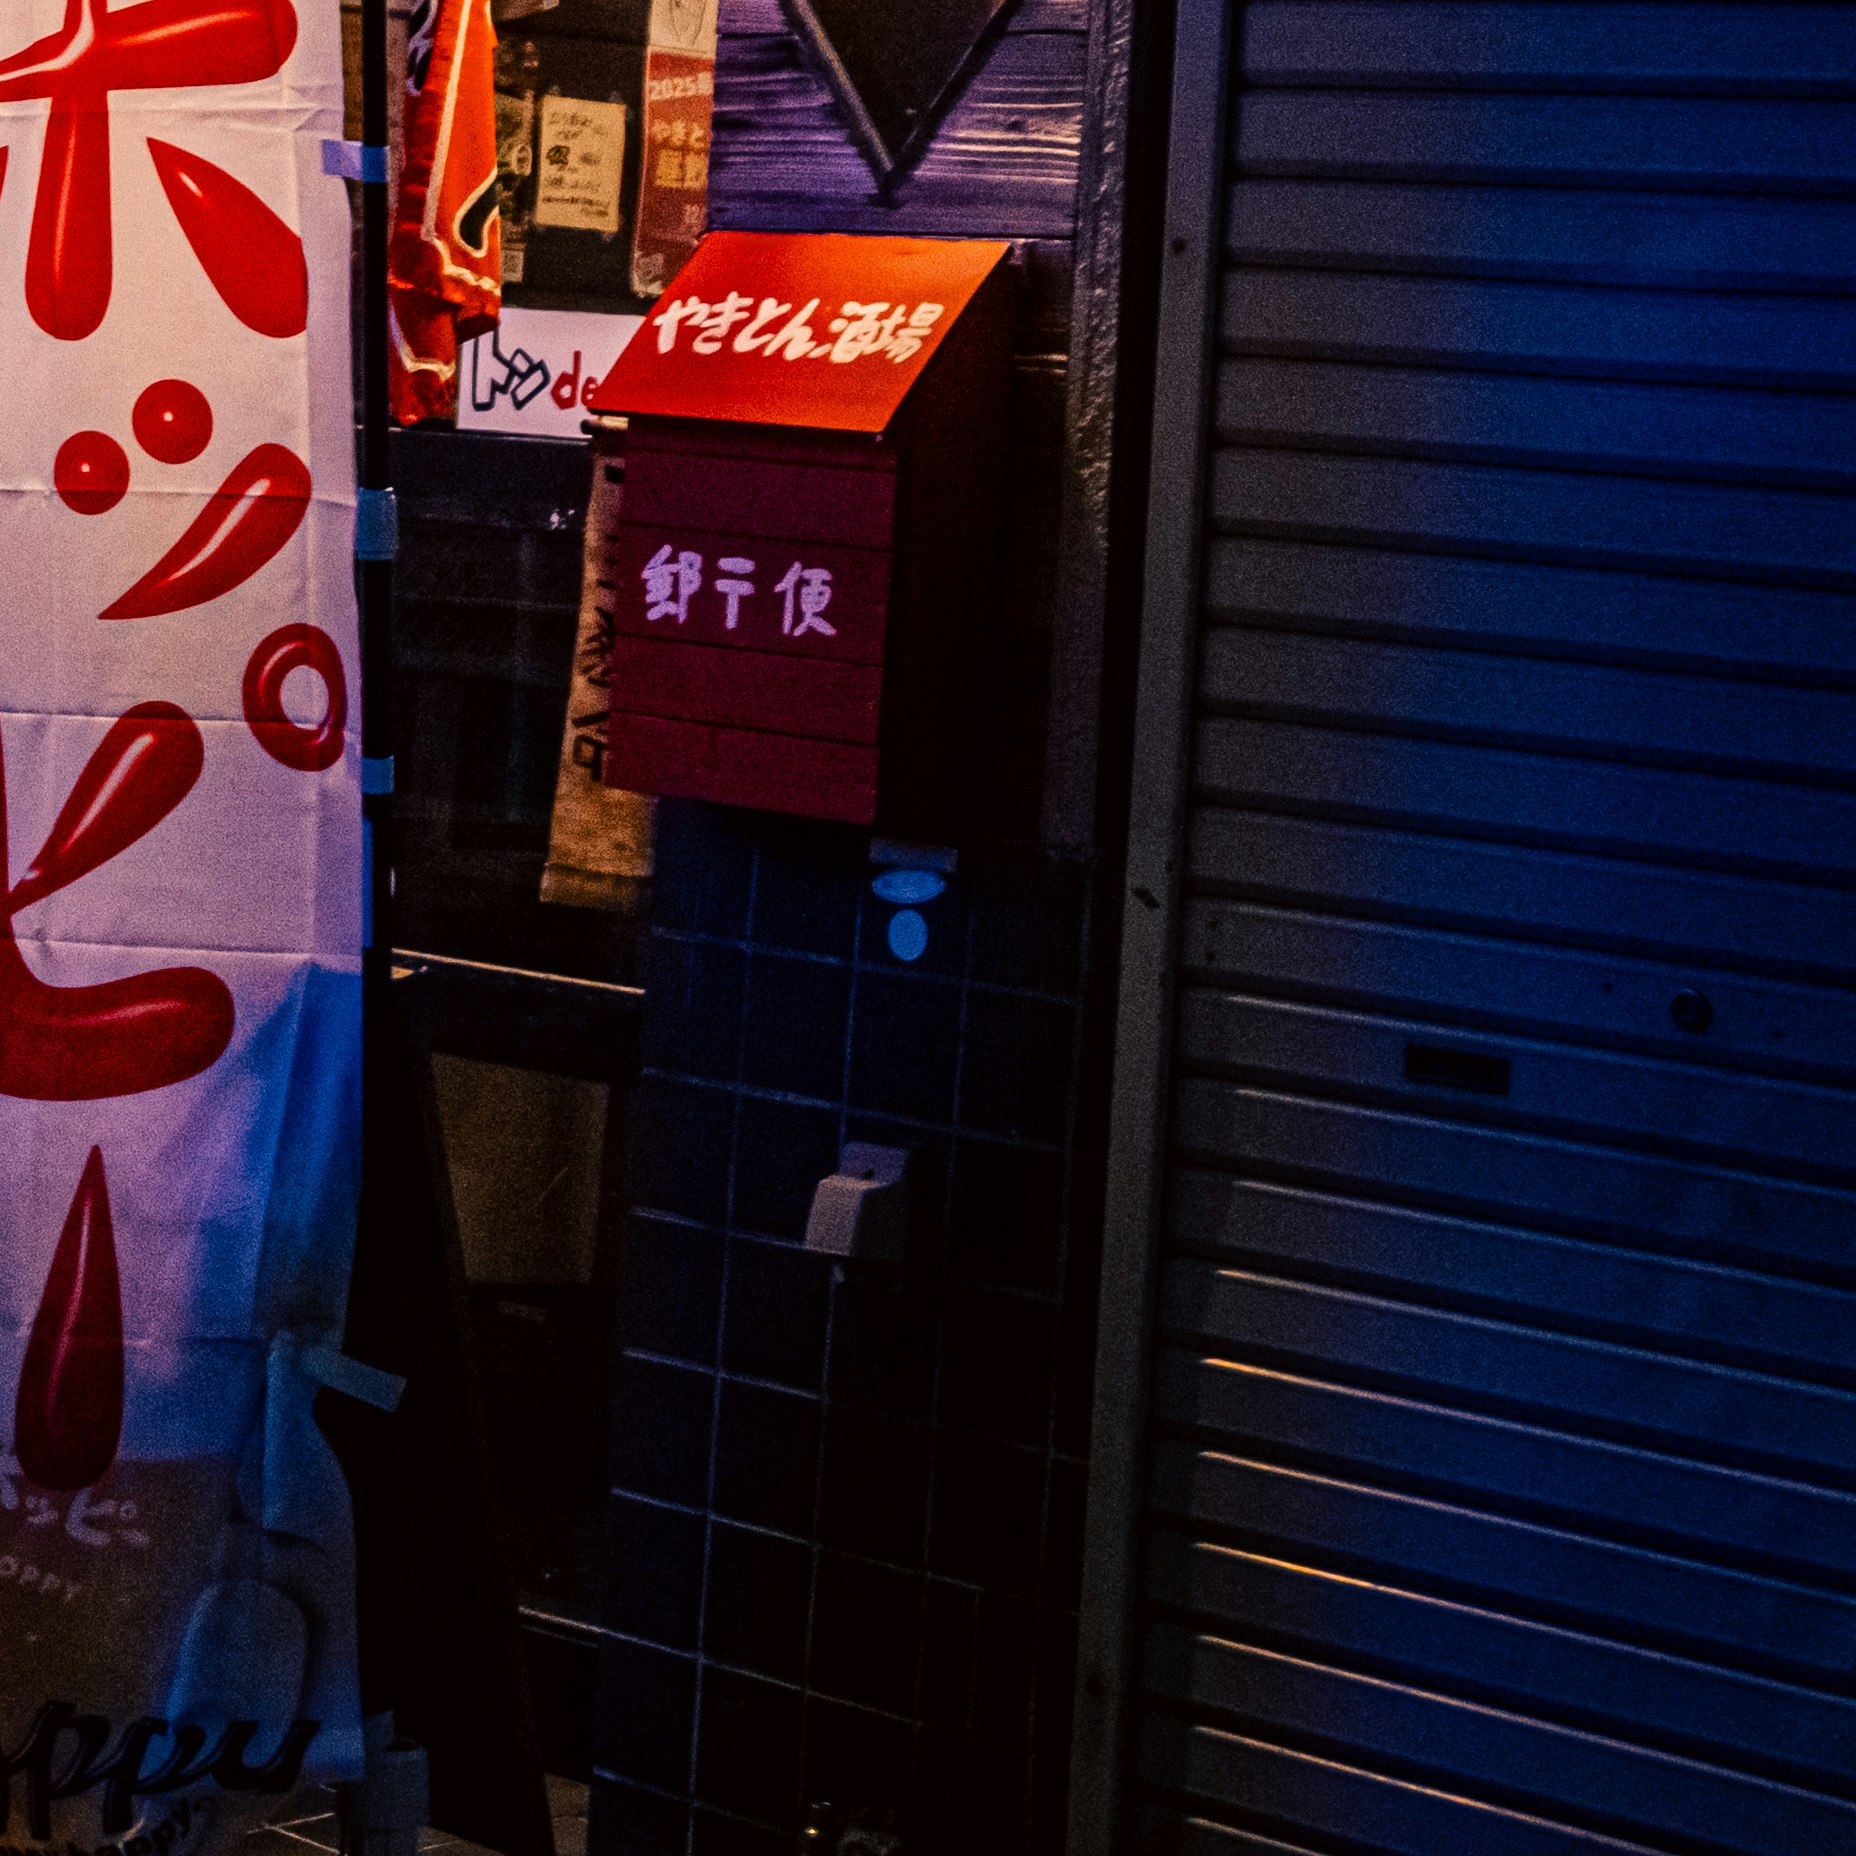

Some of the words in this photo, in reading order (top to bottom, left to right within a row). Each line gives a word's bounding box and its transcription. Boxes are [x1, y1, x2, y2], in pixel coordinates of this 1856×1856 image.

[653, 291, 946, 364] やきとん酒場
